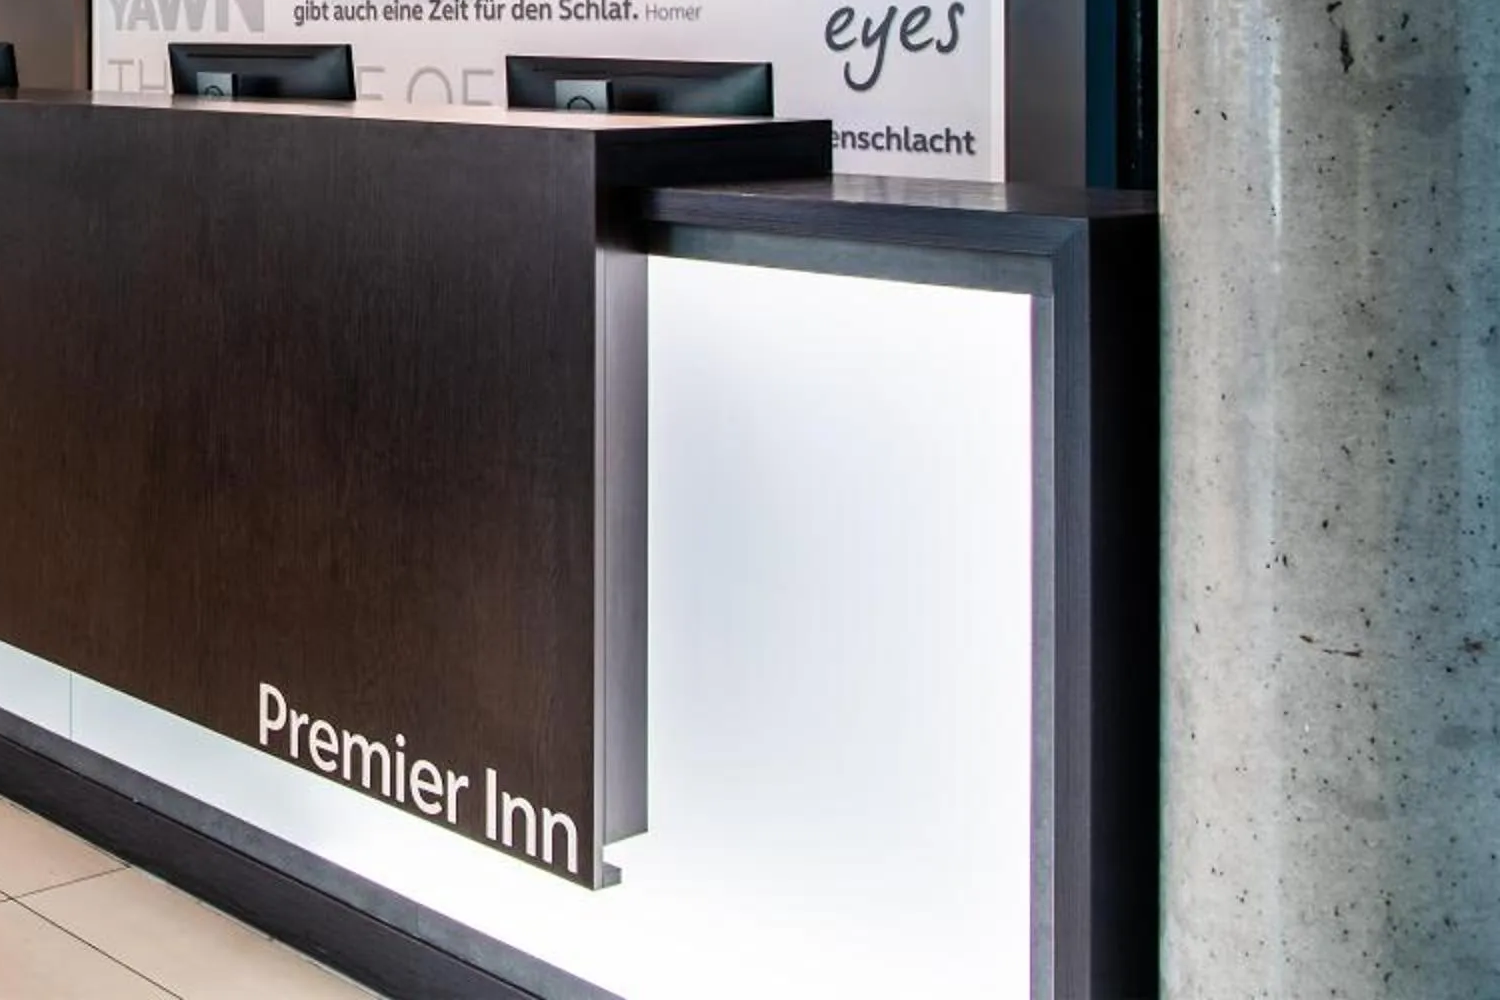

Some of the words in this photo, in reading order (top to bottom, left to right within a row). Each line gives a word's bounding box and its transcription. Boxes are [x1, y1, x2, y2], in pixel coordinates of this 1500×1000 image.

[293, 0, 330, 27] gibt
[644, 3, 702, 22] Homer
[824, 1, 965, 92] eyes
[831, 125, 976, 155] enschlacht
[258, 681, 469, 824] Premier
[485, 767, 579, 874] Inn
